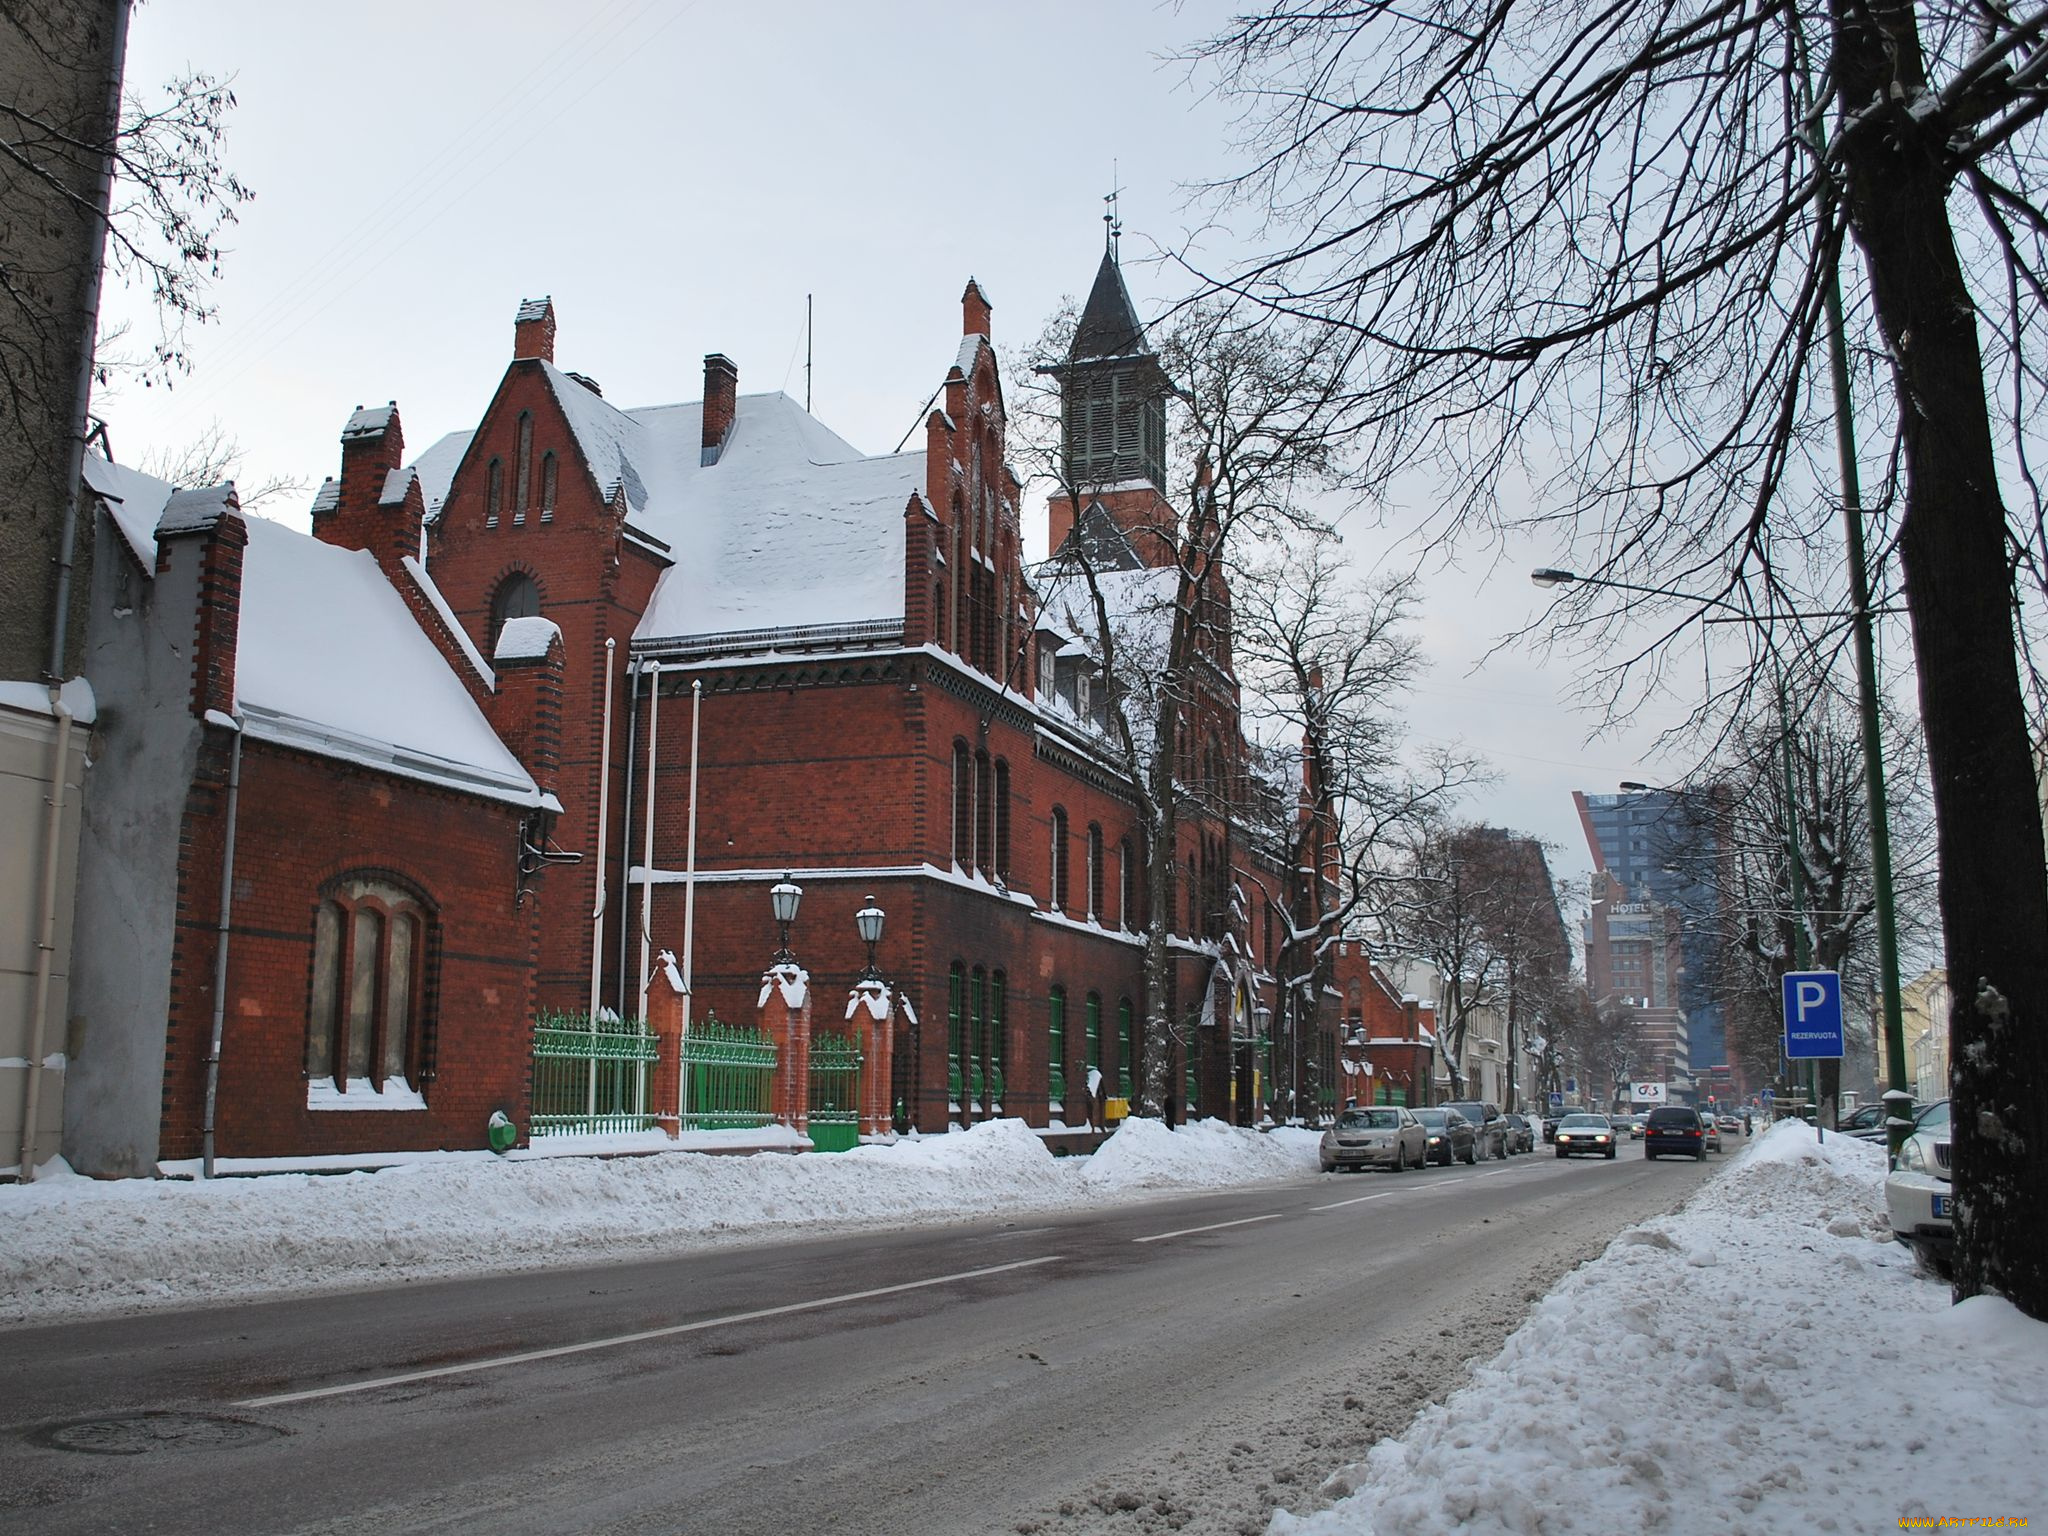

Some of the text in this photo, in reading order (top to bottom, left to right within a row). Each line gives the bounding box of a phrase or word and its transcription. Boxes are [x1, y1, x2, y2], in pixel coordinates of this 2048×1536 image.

[1611, 903, 1647, 913] HOTEL
[1796, 981, 1826, 1022] P
[1791, 1032, 1837, 1040] REZERVUOTA
